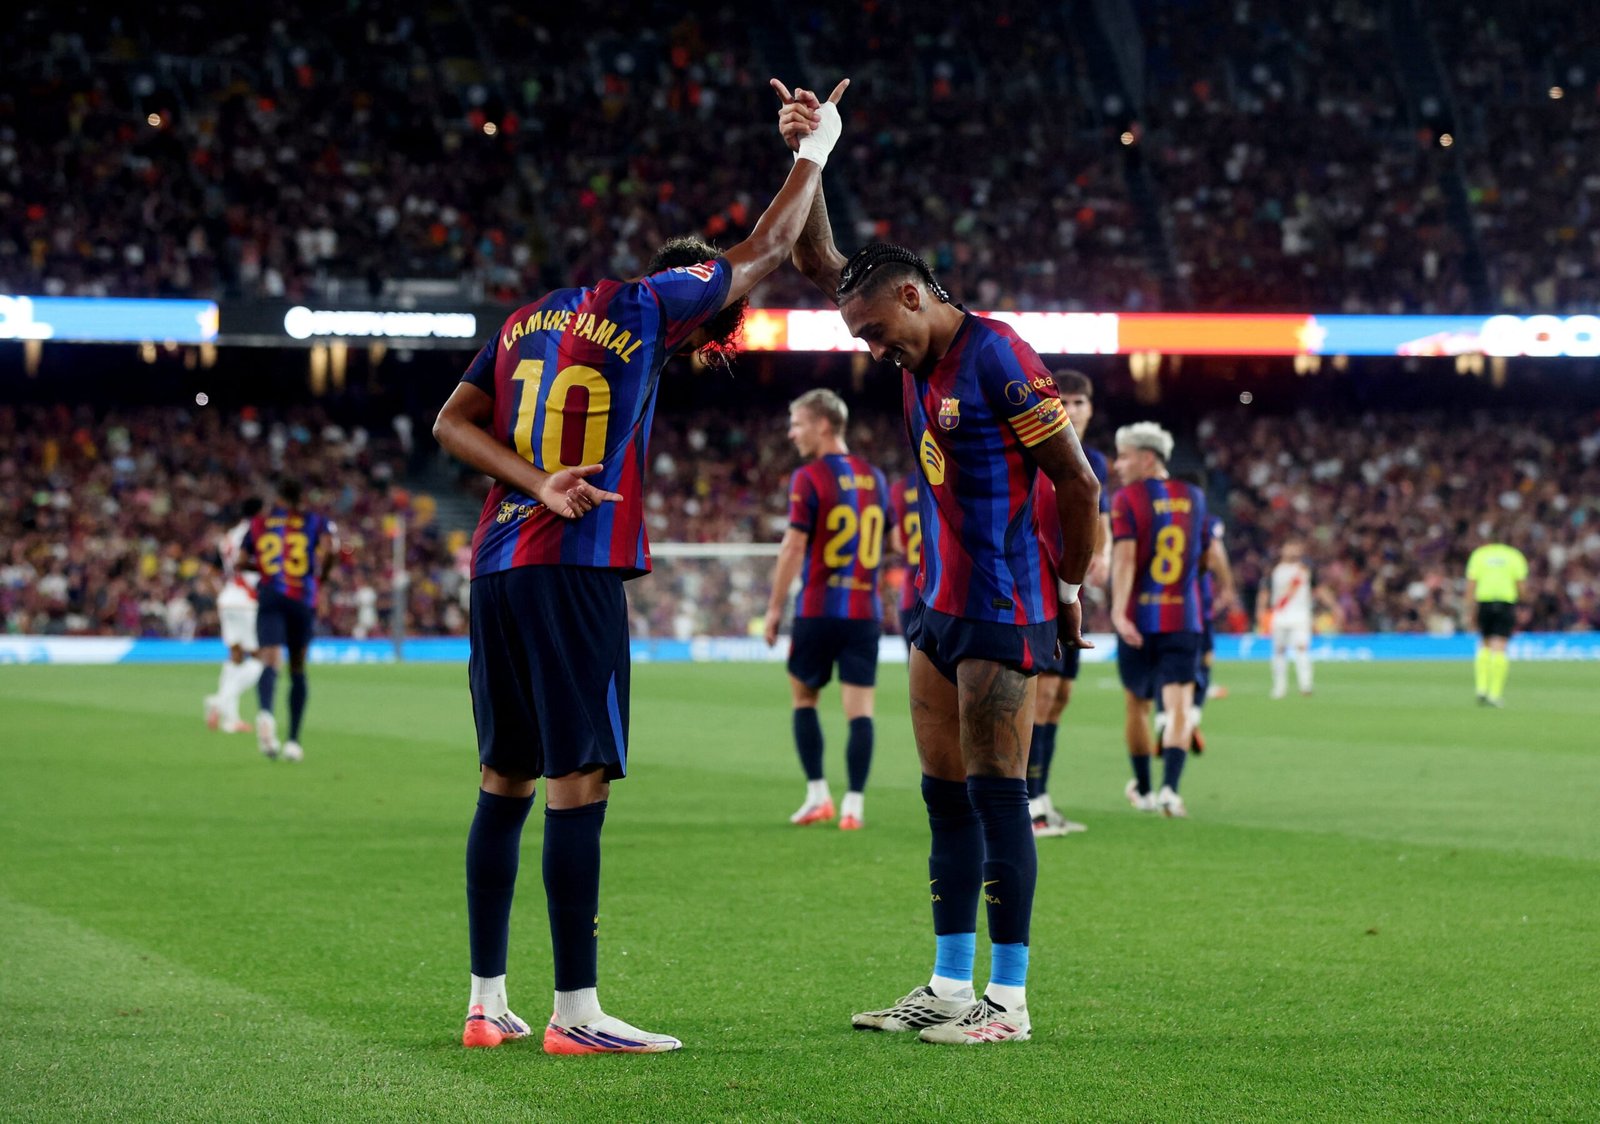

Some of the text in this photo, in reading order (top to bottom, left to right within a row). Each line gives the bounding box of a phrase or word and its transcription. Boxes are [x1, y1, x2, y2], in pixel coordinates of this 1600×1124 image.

[503, 310, 576, 352] LAMINE
[572, 312, 643, 364] YAMAL
[511, 359, 611, 474] 10
[1009, 376, 1053, 403] Midea
[256, 531, 309, 578] 23
[823, 504, 885, 569] 20
[1150, 524, 1186, 585] 8
